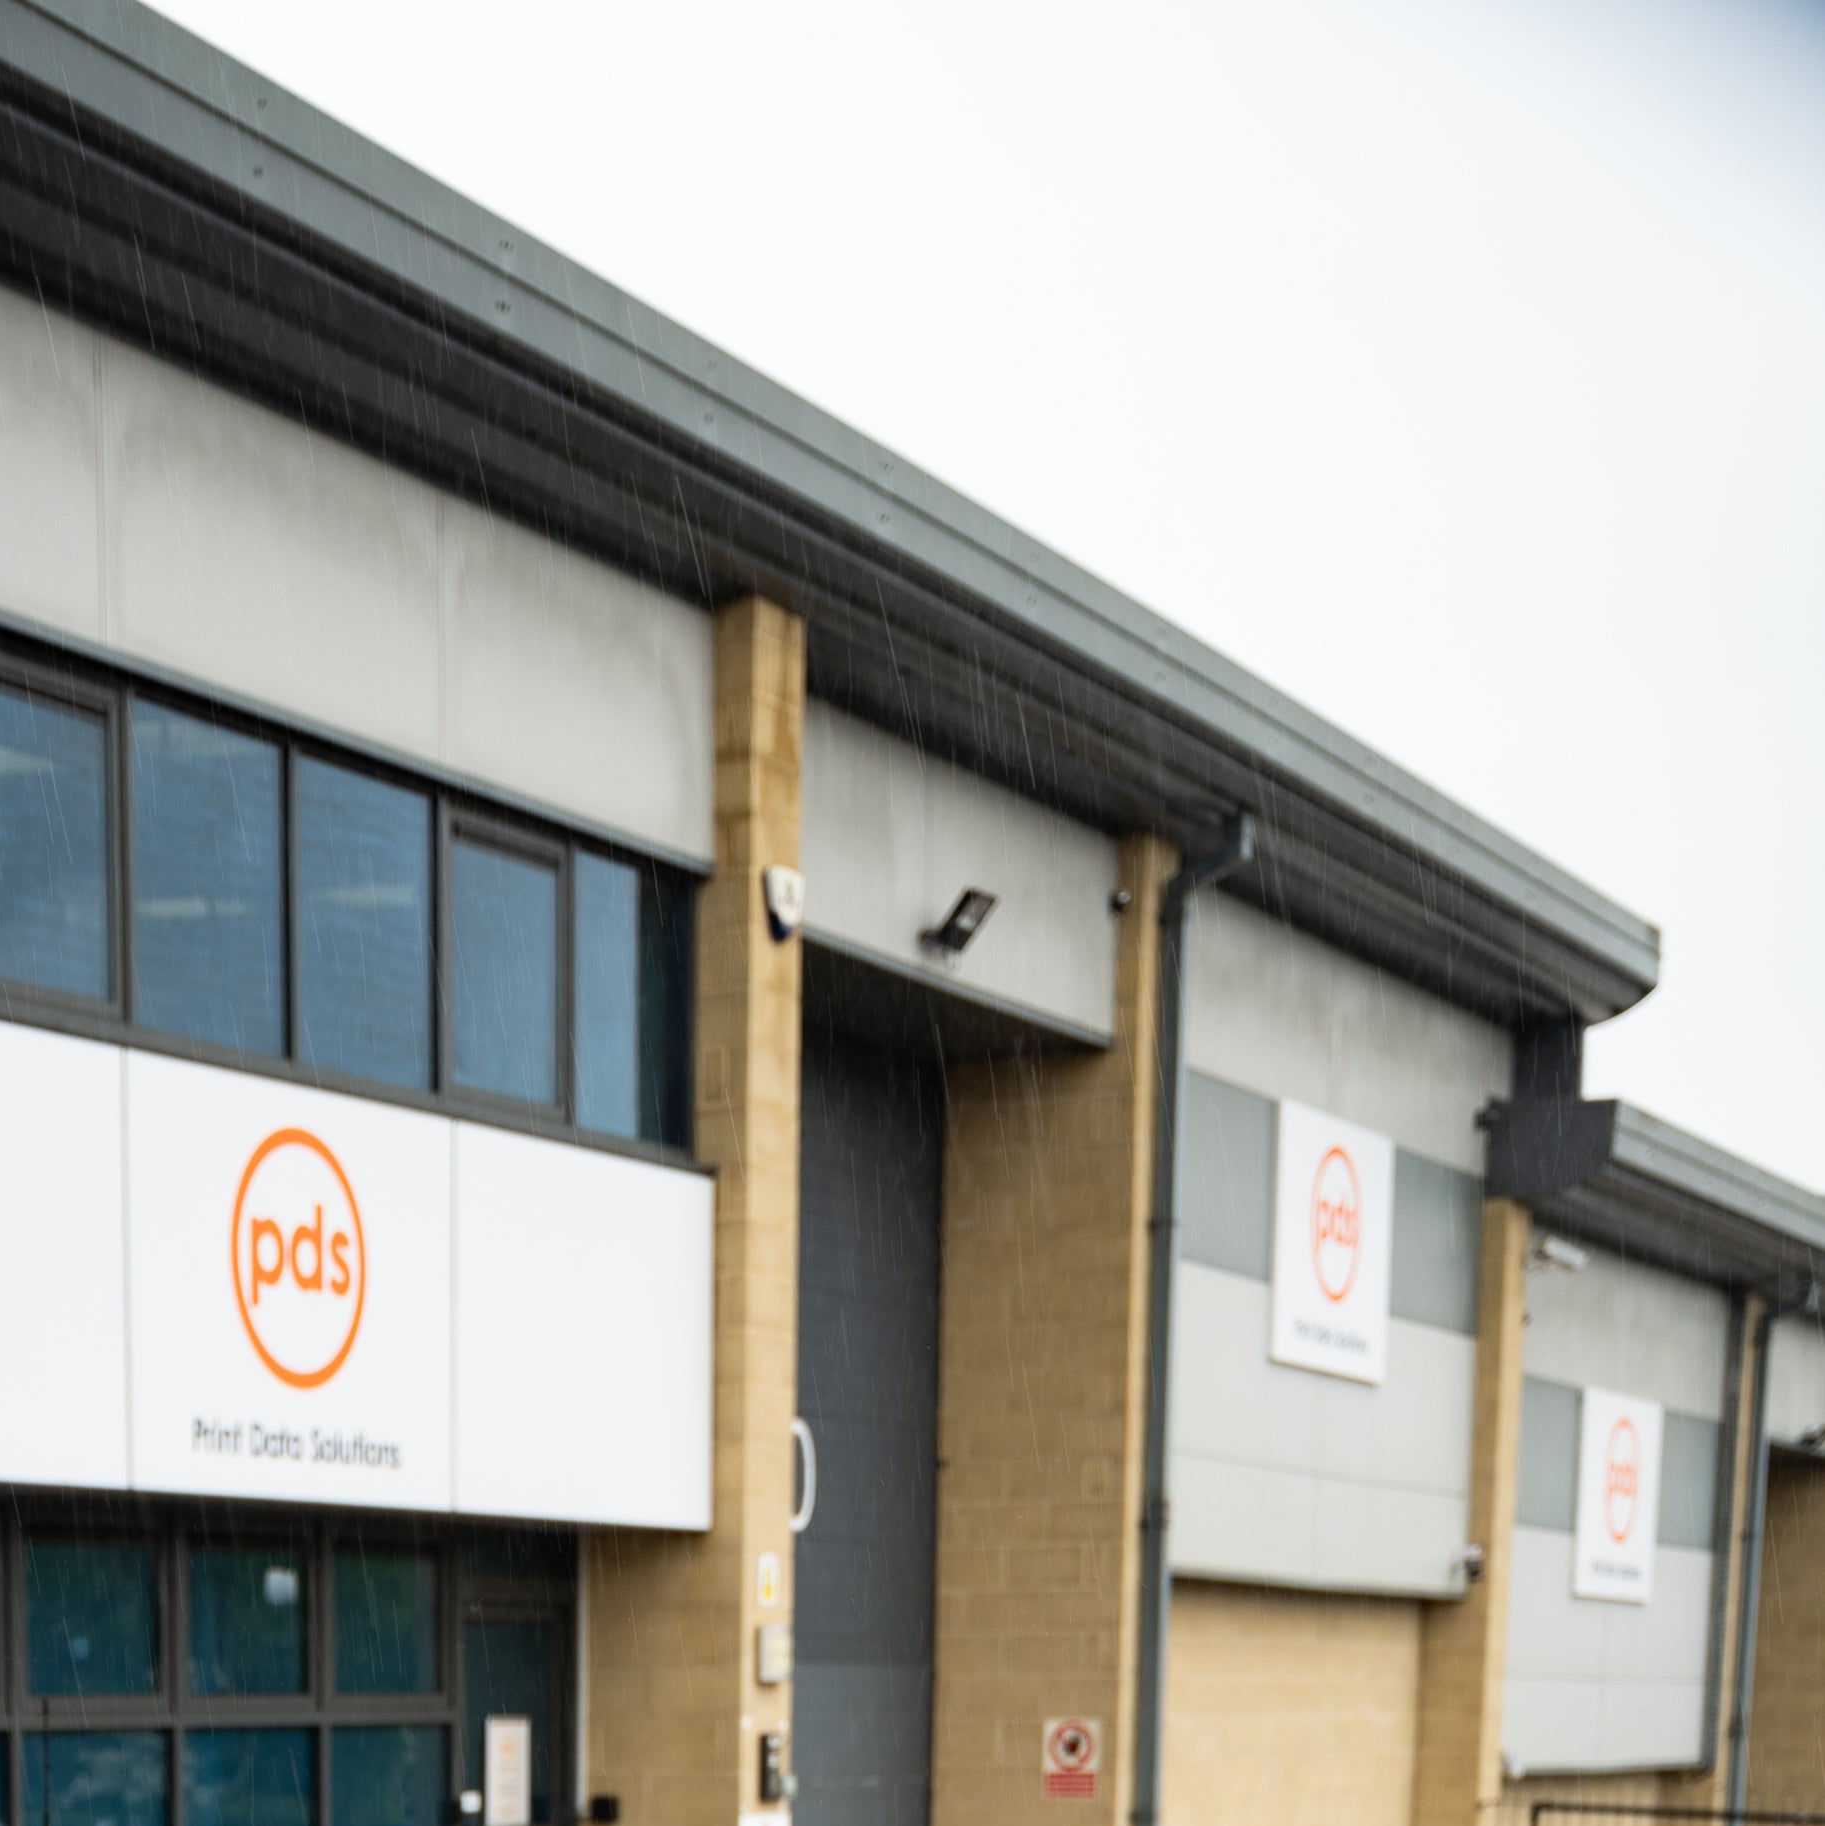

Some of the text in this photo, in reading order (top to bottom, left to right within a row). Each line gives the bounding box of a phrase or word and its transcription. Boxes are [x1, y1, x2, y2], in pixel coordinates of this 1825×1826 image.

[251, 1204, 351, 1306] pds
[192, 1416, 402, 1470] Print Data Solutions
